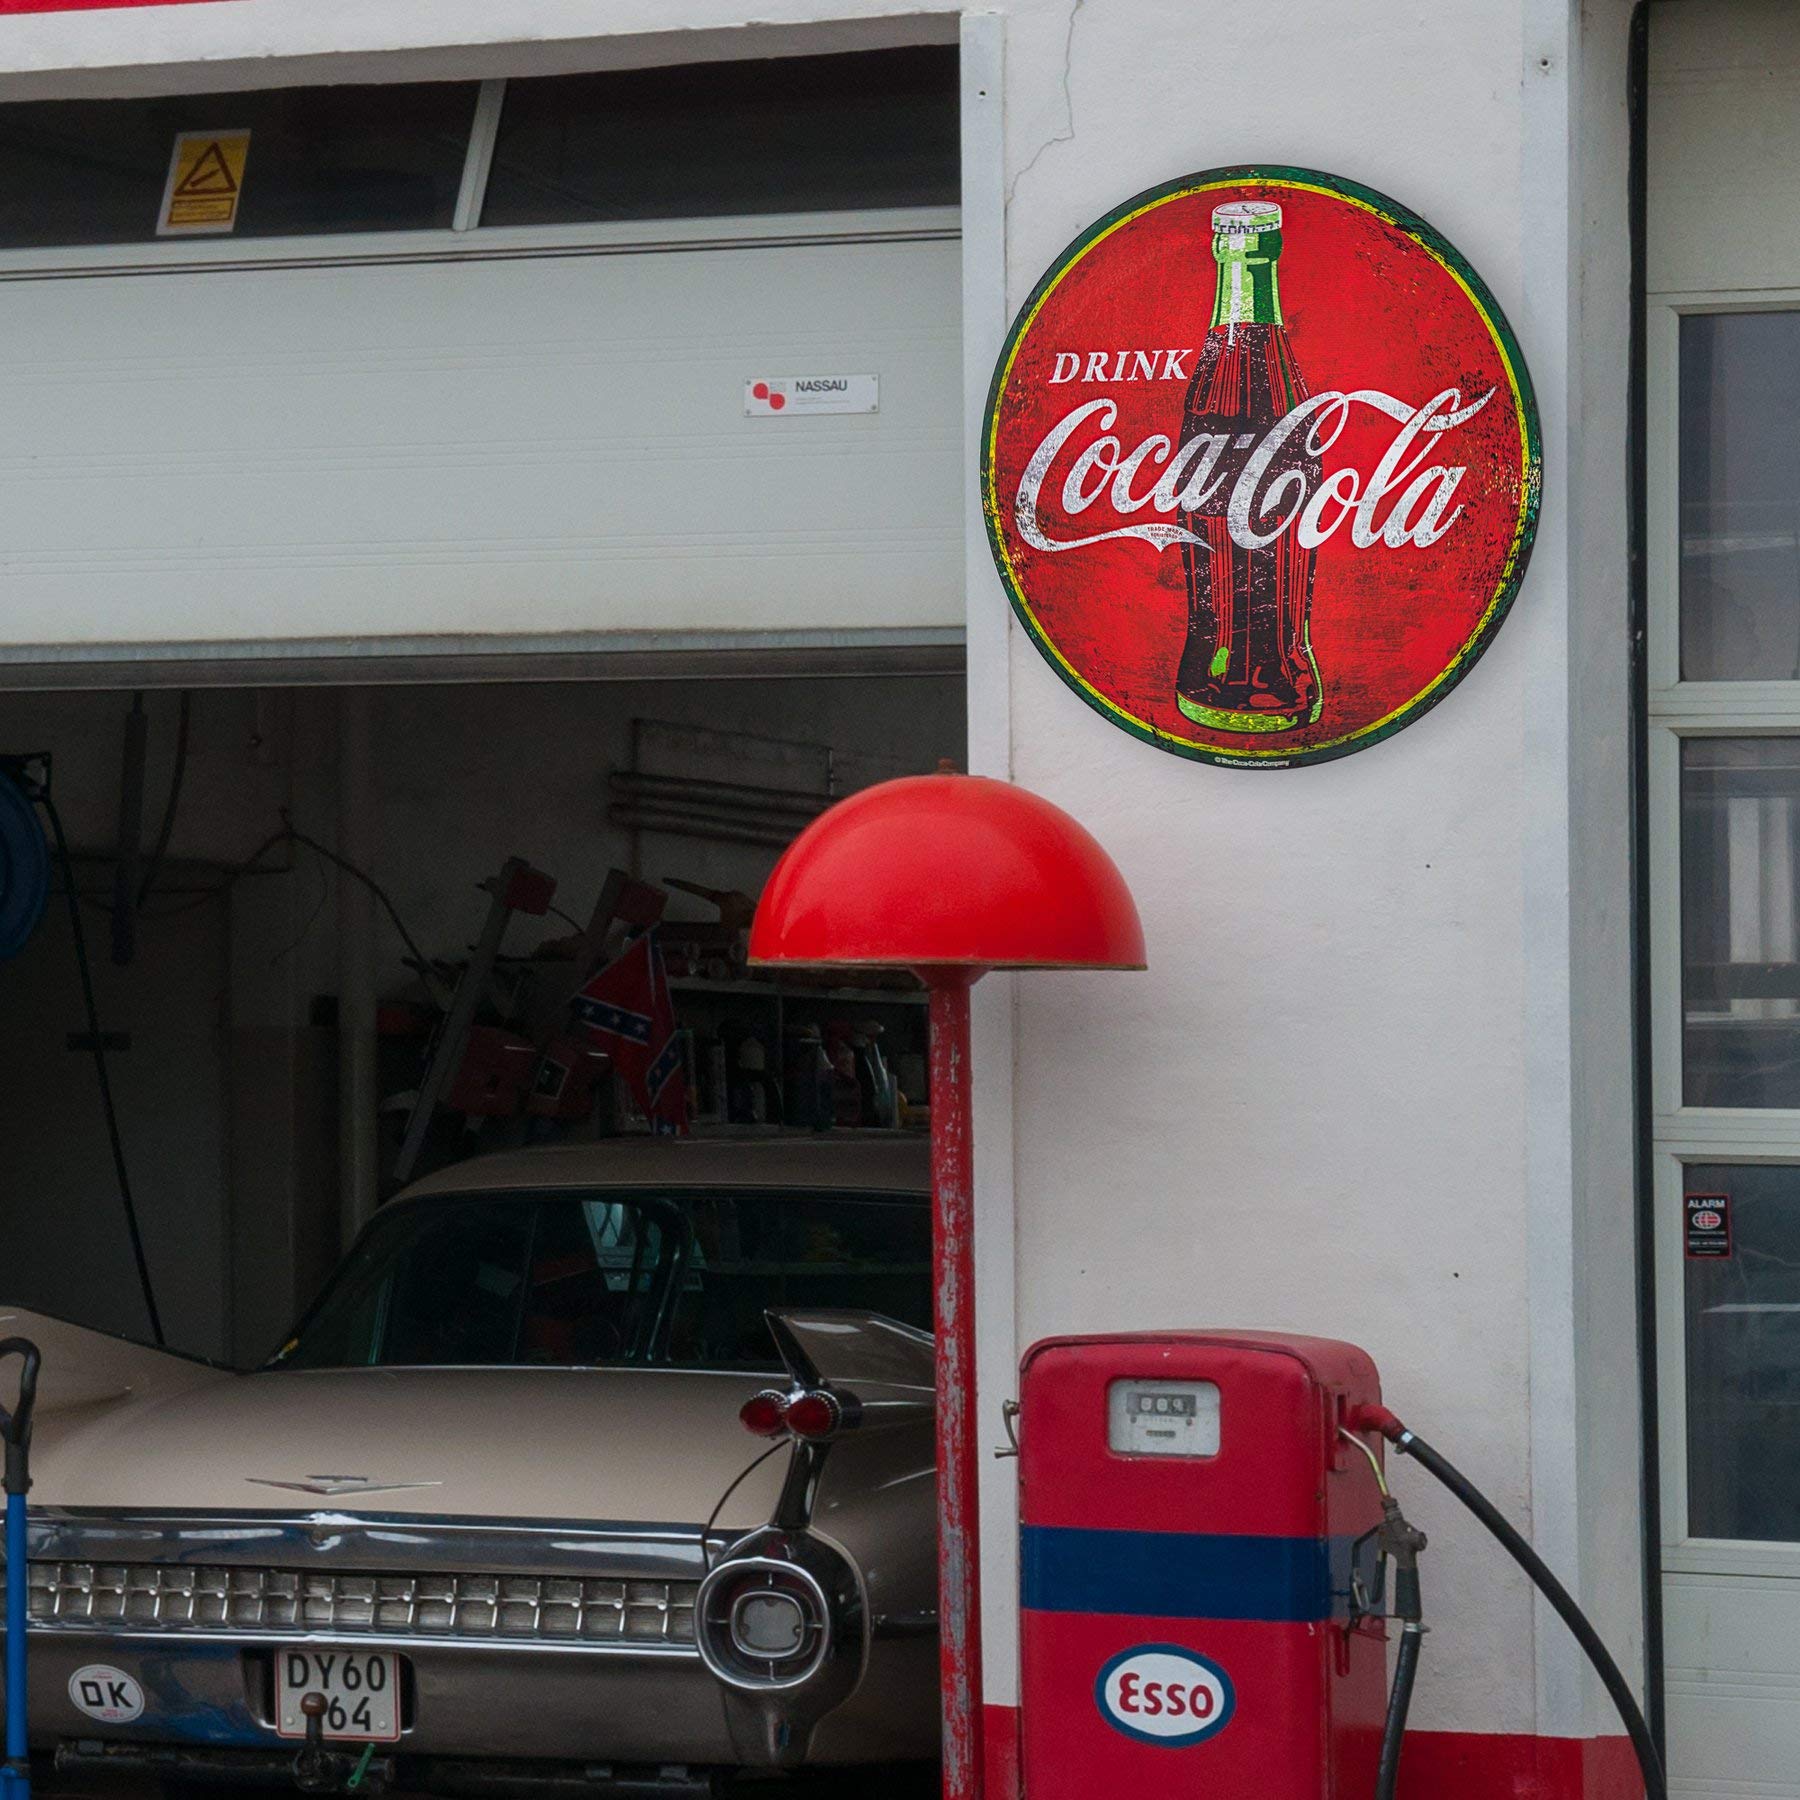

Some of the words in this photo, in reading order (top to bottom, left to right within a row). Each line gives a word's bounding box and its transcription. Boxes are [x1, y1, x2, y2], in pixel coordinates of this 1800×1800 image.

[1048, 349, 1193, 384] DRINK
[795, 379, 848, 393] NASSAU
[1016, 386, 1497, 553] Coca-Cola
[1687, 1199, 1726, 1208] ALARM
[80, 1681, 134, 1708] DK
